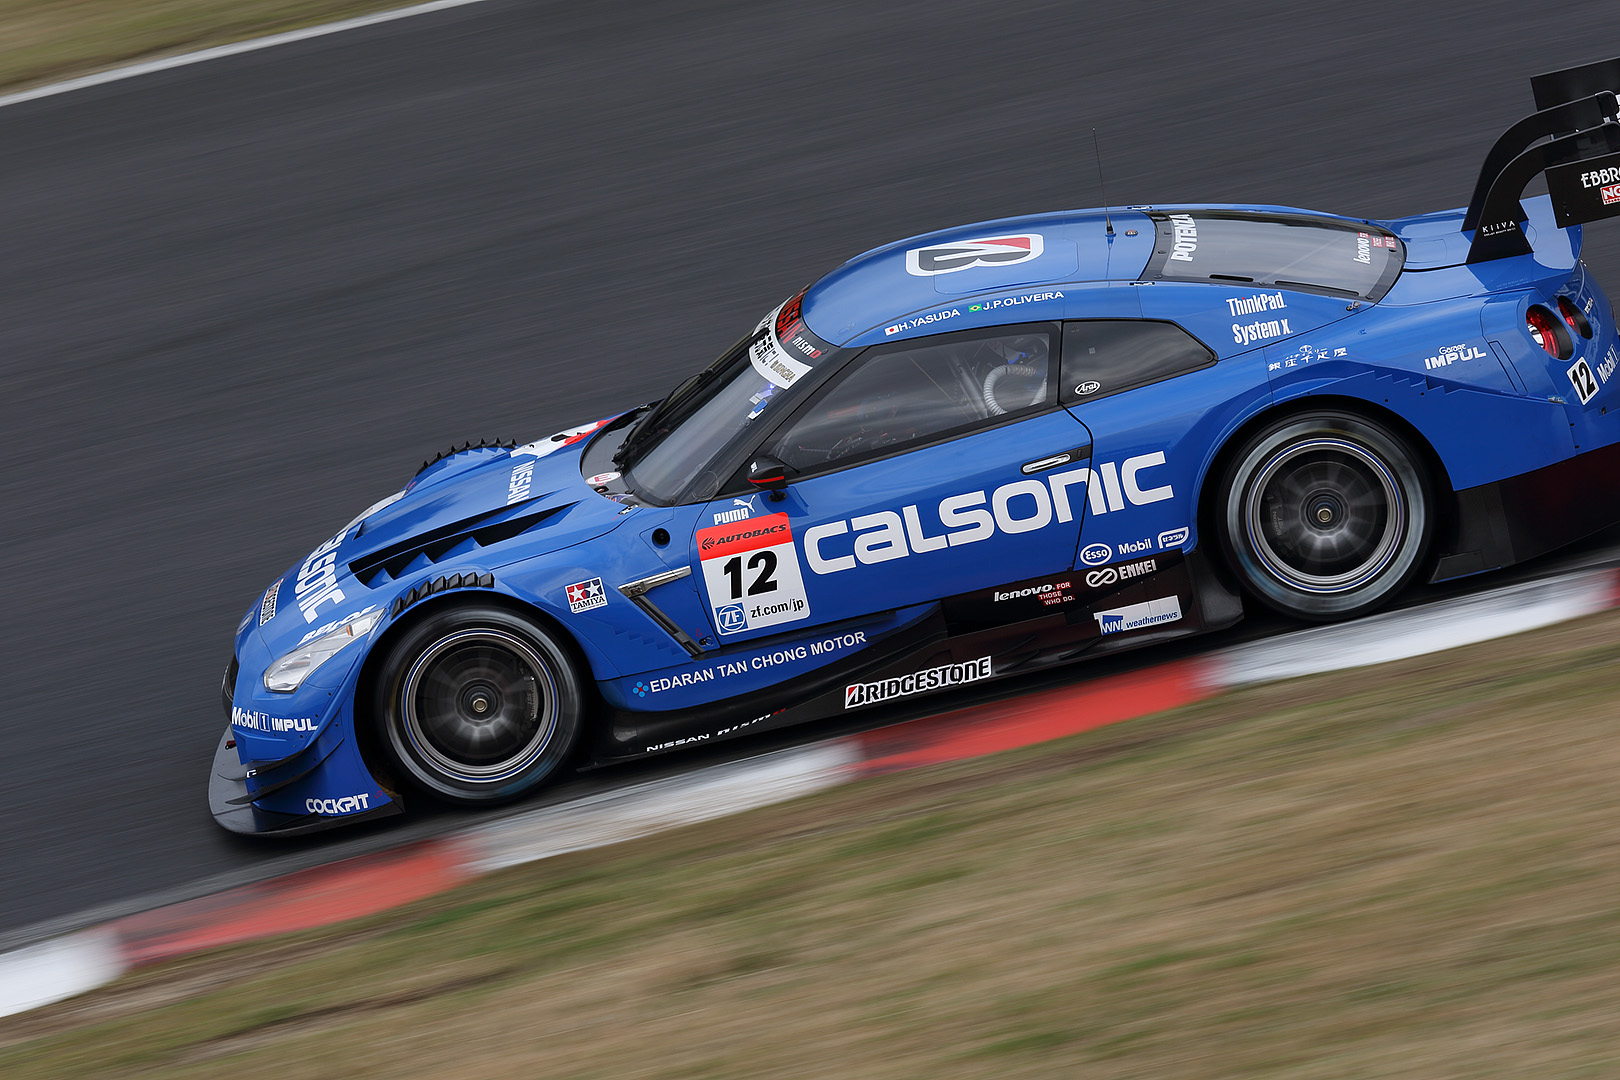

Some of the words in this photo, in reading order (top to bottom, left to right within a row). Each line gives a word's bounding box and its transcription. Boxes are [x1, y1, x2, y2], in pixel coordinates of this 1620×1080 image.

[1581, 166, 1620, 188] EBBR
[1169, 213, 1198, 262] POTENZA
[899, 308, 961, 333] H.YASUDA
[983, 291, 1065, 311] J.P.OLIVEIRA
[1232, 320, 1282, 346] System
[1424, 346, 1487, 370] IMPUL
[1438, 343, 1467, 356] Garage
[1077, 382, 1098, 394] Arai
[1572, 362, 1596, 400] 12
[506, 459, 537, 506] NISSAN
[713, 507, 750, 526] PUMA
[716, 523, 787, 546] AUTOBACS
[1118, 538, 1152, 555] Mobil
[723, 550, 778, 600] 12
[1118, 559, 1157, 580] ENKEI
[1039, 591, 1063, 600] THOSE
[1056, 582, 1071, 590] FOR
[570, 596, 606, 610] TAMIYA
[750, 598, 805, 619] zf.com/jp
[1044, 598, 1061, 606] WHO
[720, 612, 742, 629] ZF
[1126, 611, 1178, 629] weathernews
[650, 668, 714, 693] EDARAN
[717, 660, 748, 678] TAN
[751, 646, 808, 670] CHONG
[810, 631, 867, 656] MOTOR
[846, 657, 991, 708] BRIDGESTONE
[231, 706, 260, 730] Mobil
[272, 718, 318, 732] IMPUL
[646, 733, 710, 752] NISSAN
[305, 793, 369, 814] COCKPIT
